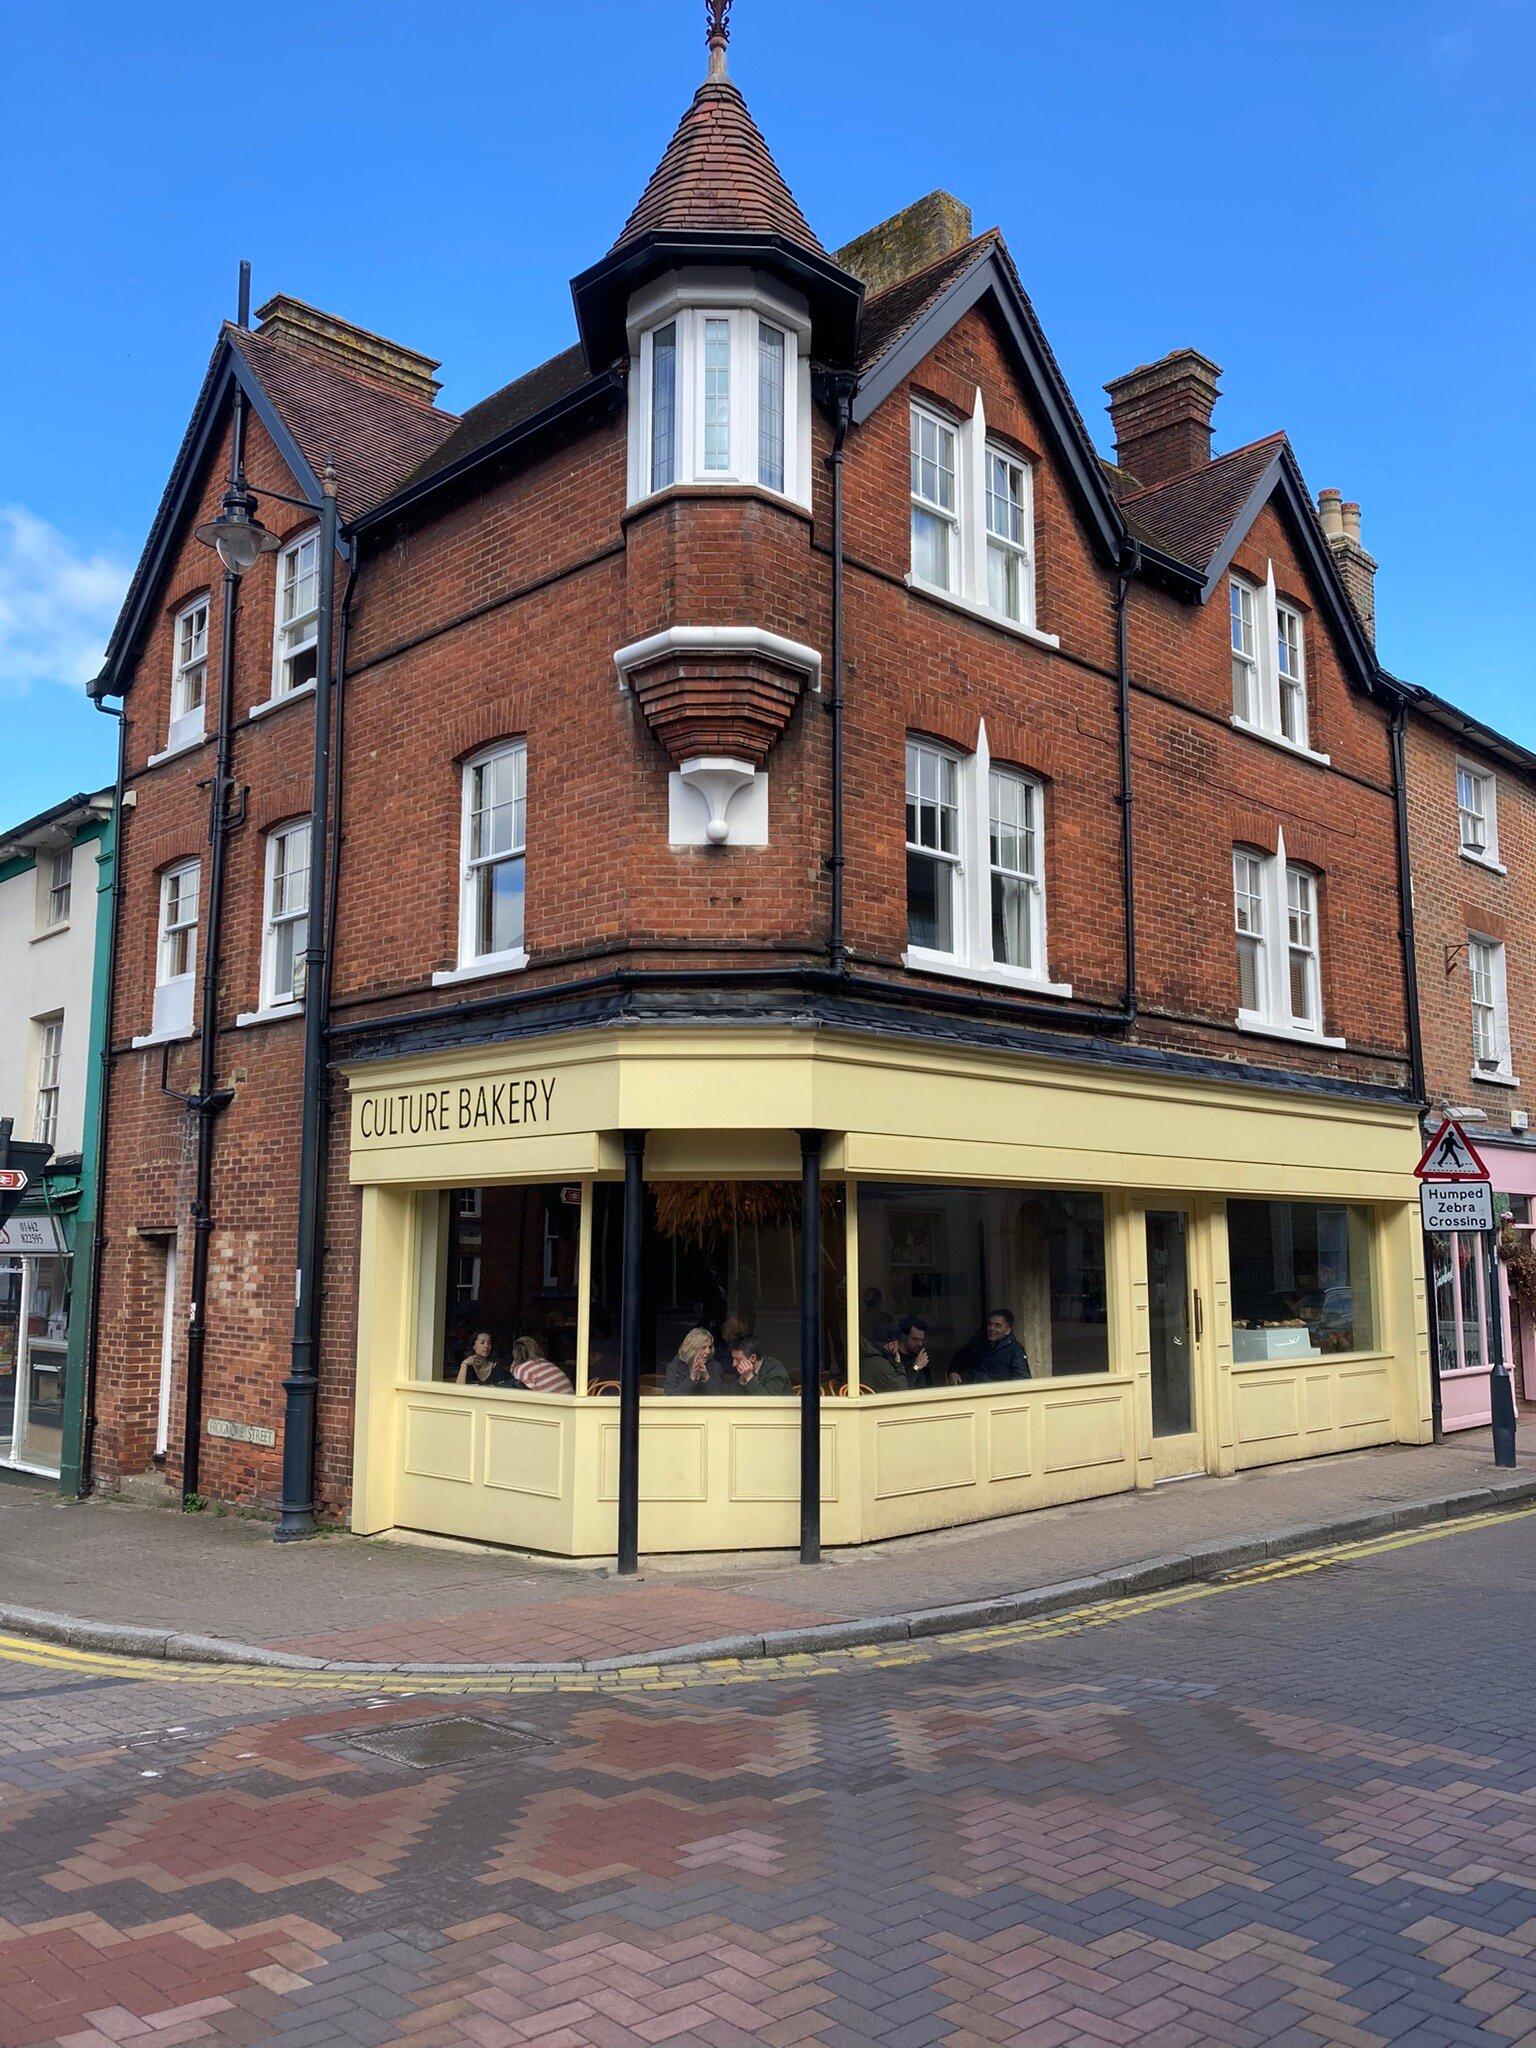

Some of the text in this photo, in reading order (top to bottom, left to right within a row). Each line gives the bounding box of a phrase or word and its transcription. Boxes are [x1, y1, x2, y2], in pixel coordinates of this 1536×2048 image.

[361, 1077, 556, 1138] CULTURE BAKERY
[1428, 1188, 1483, 1201] Humped
[1438, 1202, 1476, 1213] Zebra
[1428, 1216, 1487, 1228] Crossing
[248, 1427, 273, 1444] STREET
